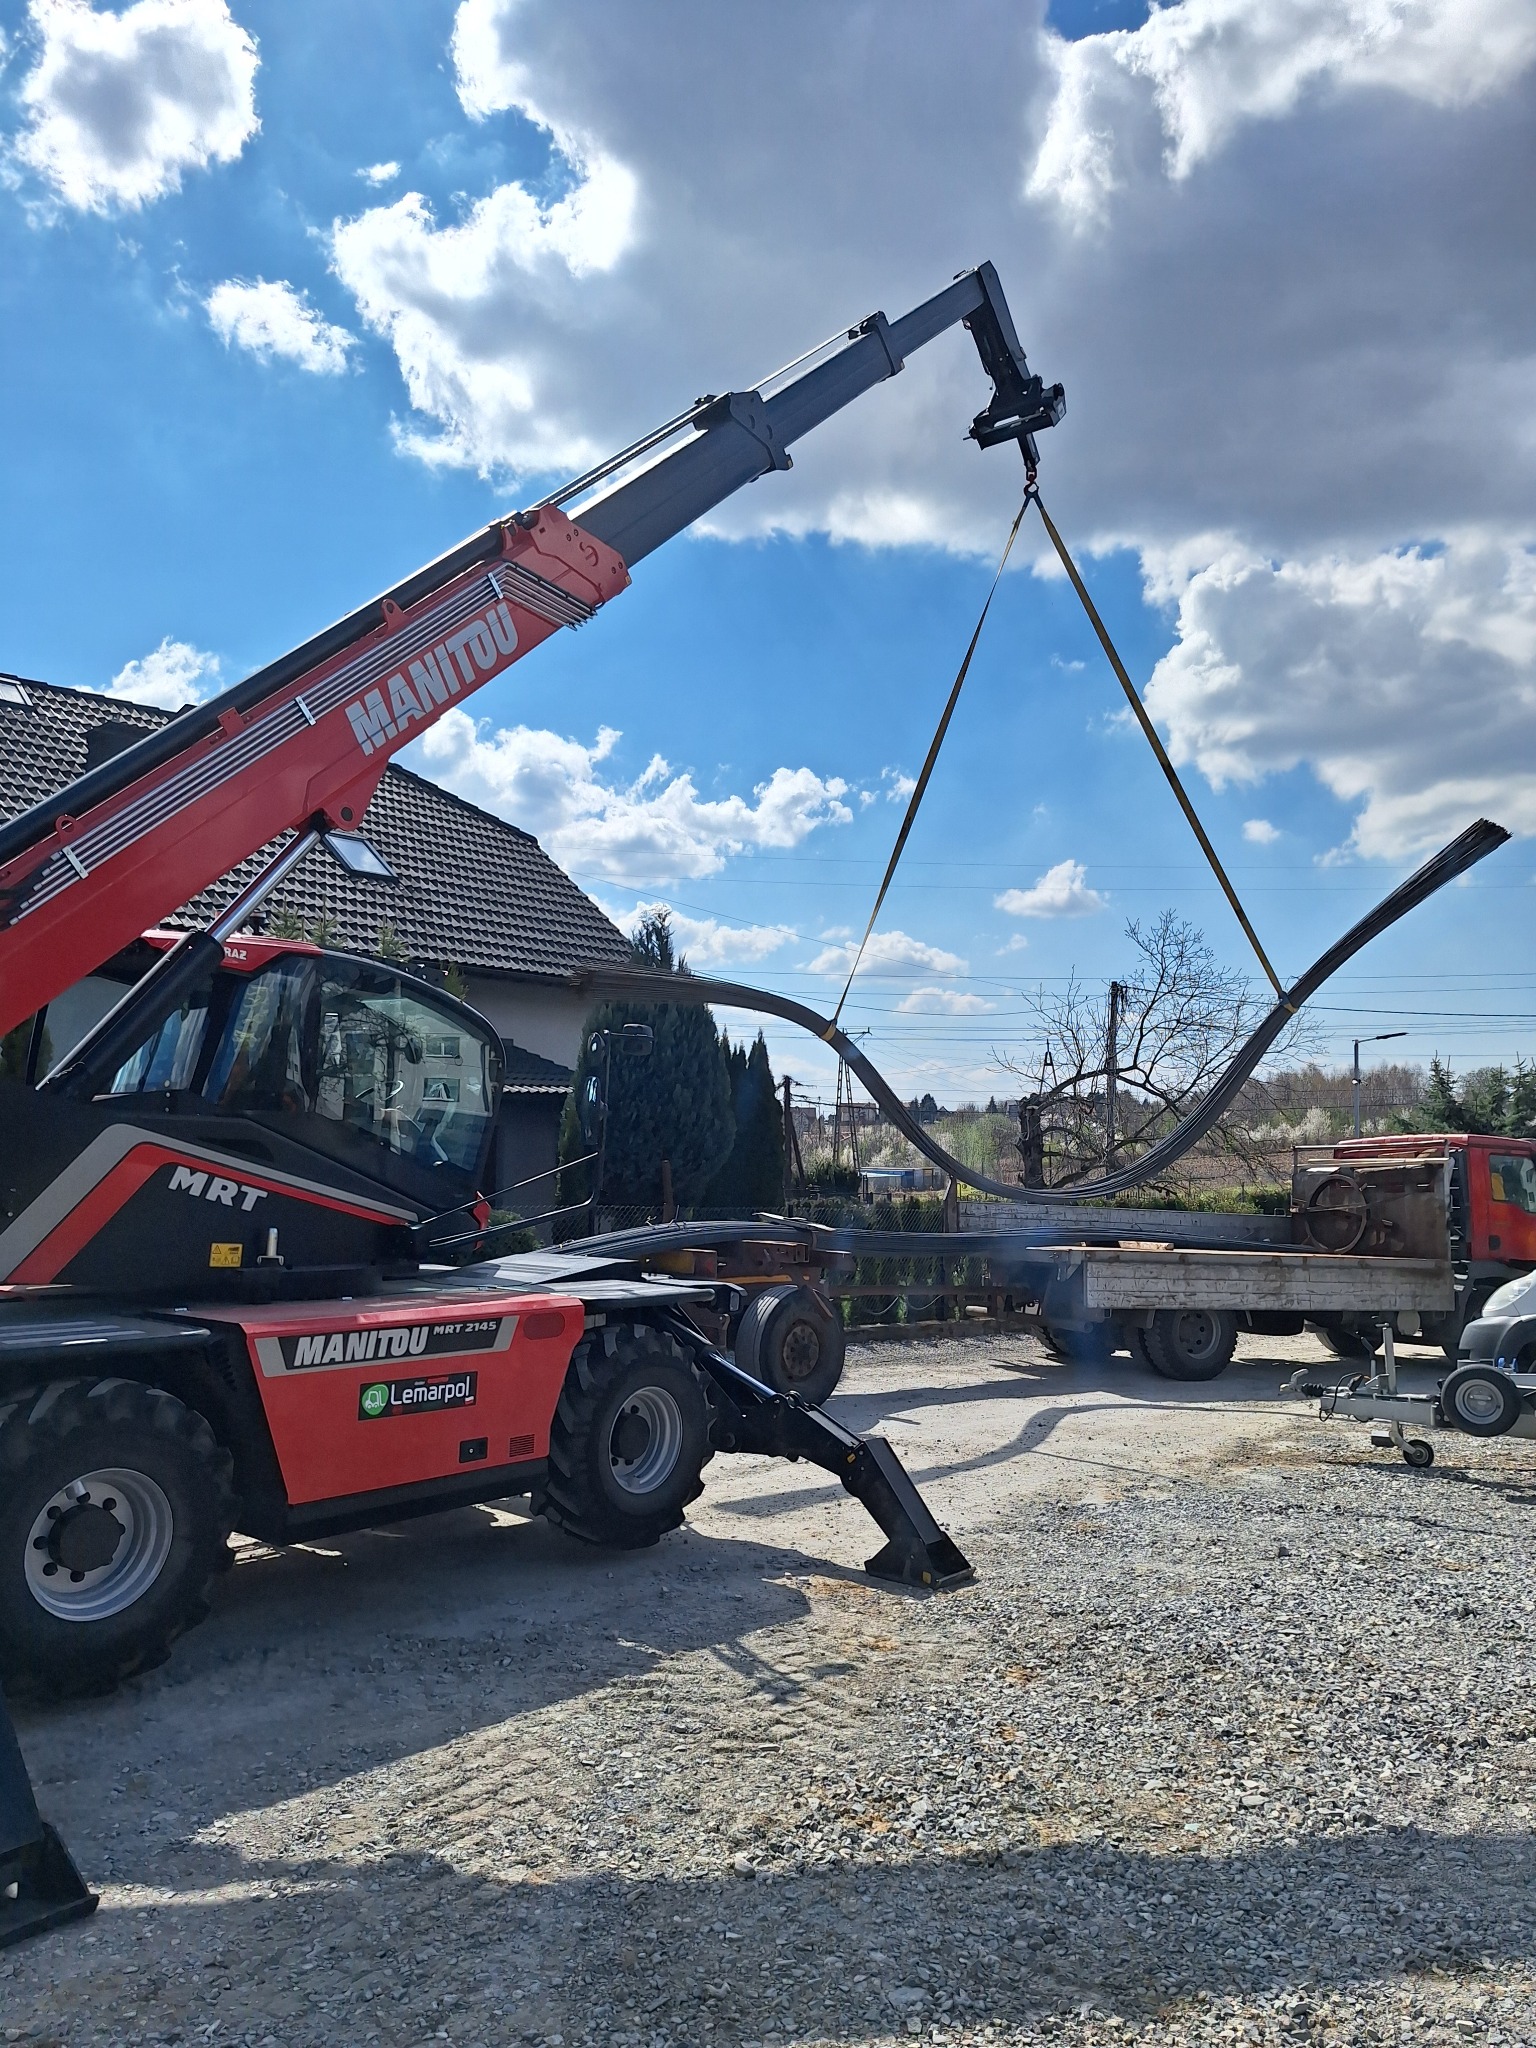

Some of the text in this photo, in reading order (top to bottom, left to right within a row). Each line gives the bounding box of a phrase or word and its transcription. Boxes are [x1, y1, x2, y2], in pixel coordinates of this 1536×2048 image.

[345, 601, 518, 756] MANITOU
[168, 1166, 268, 1212] MRT
[293, 1326, 429, 1367] MANITOU
[433, 1321, 497, 1336] MRT 2145
[390, 1375, 470, 1405] Lemarpol
